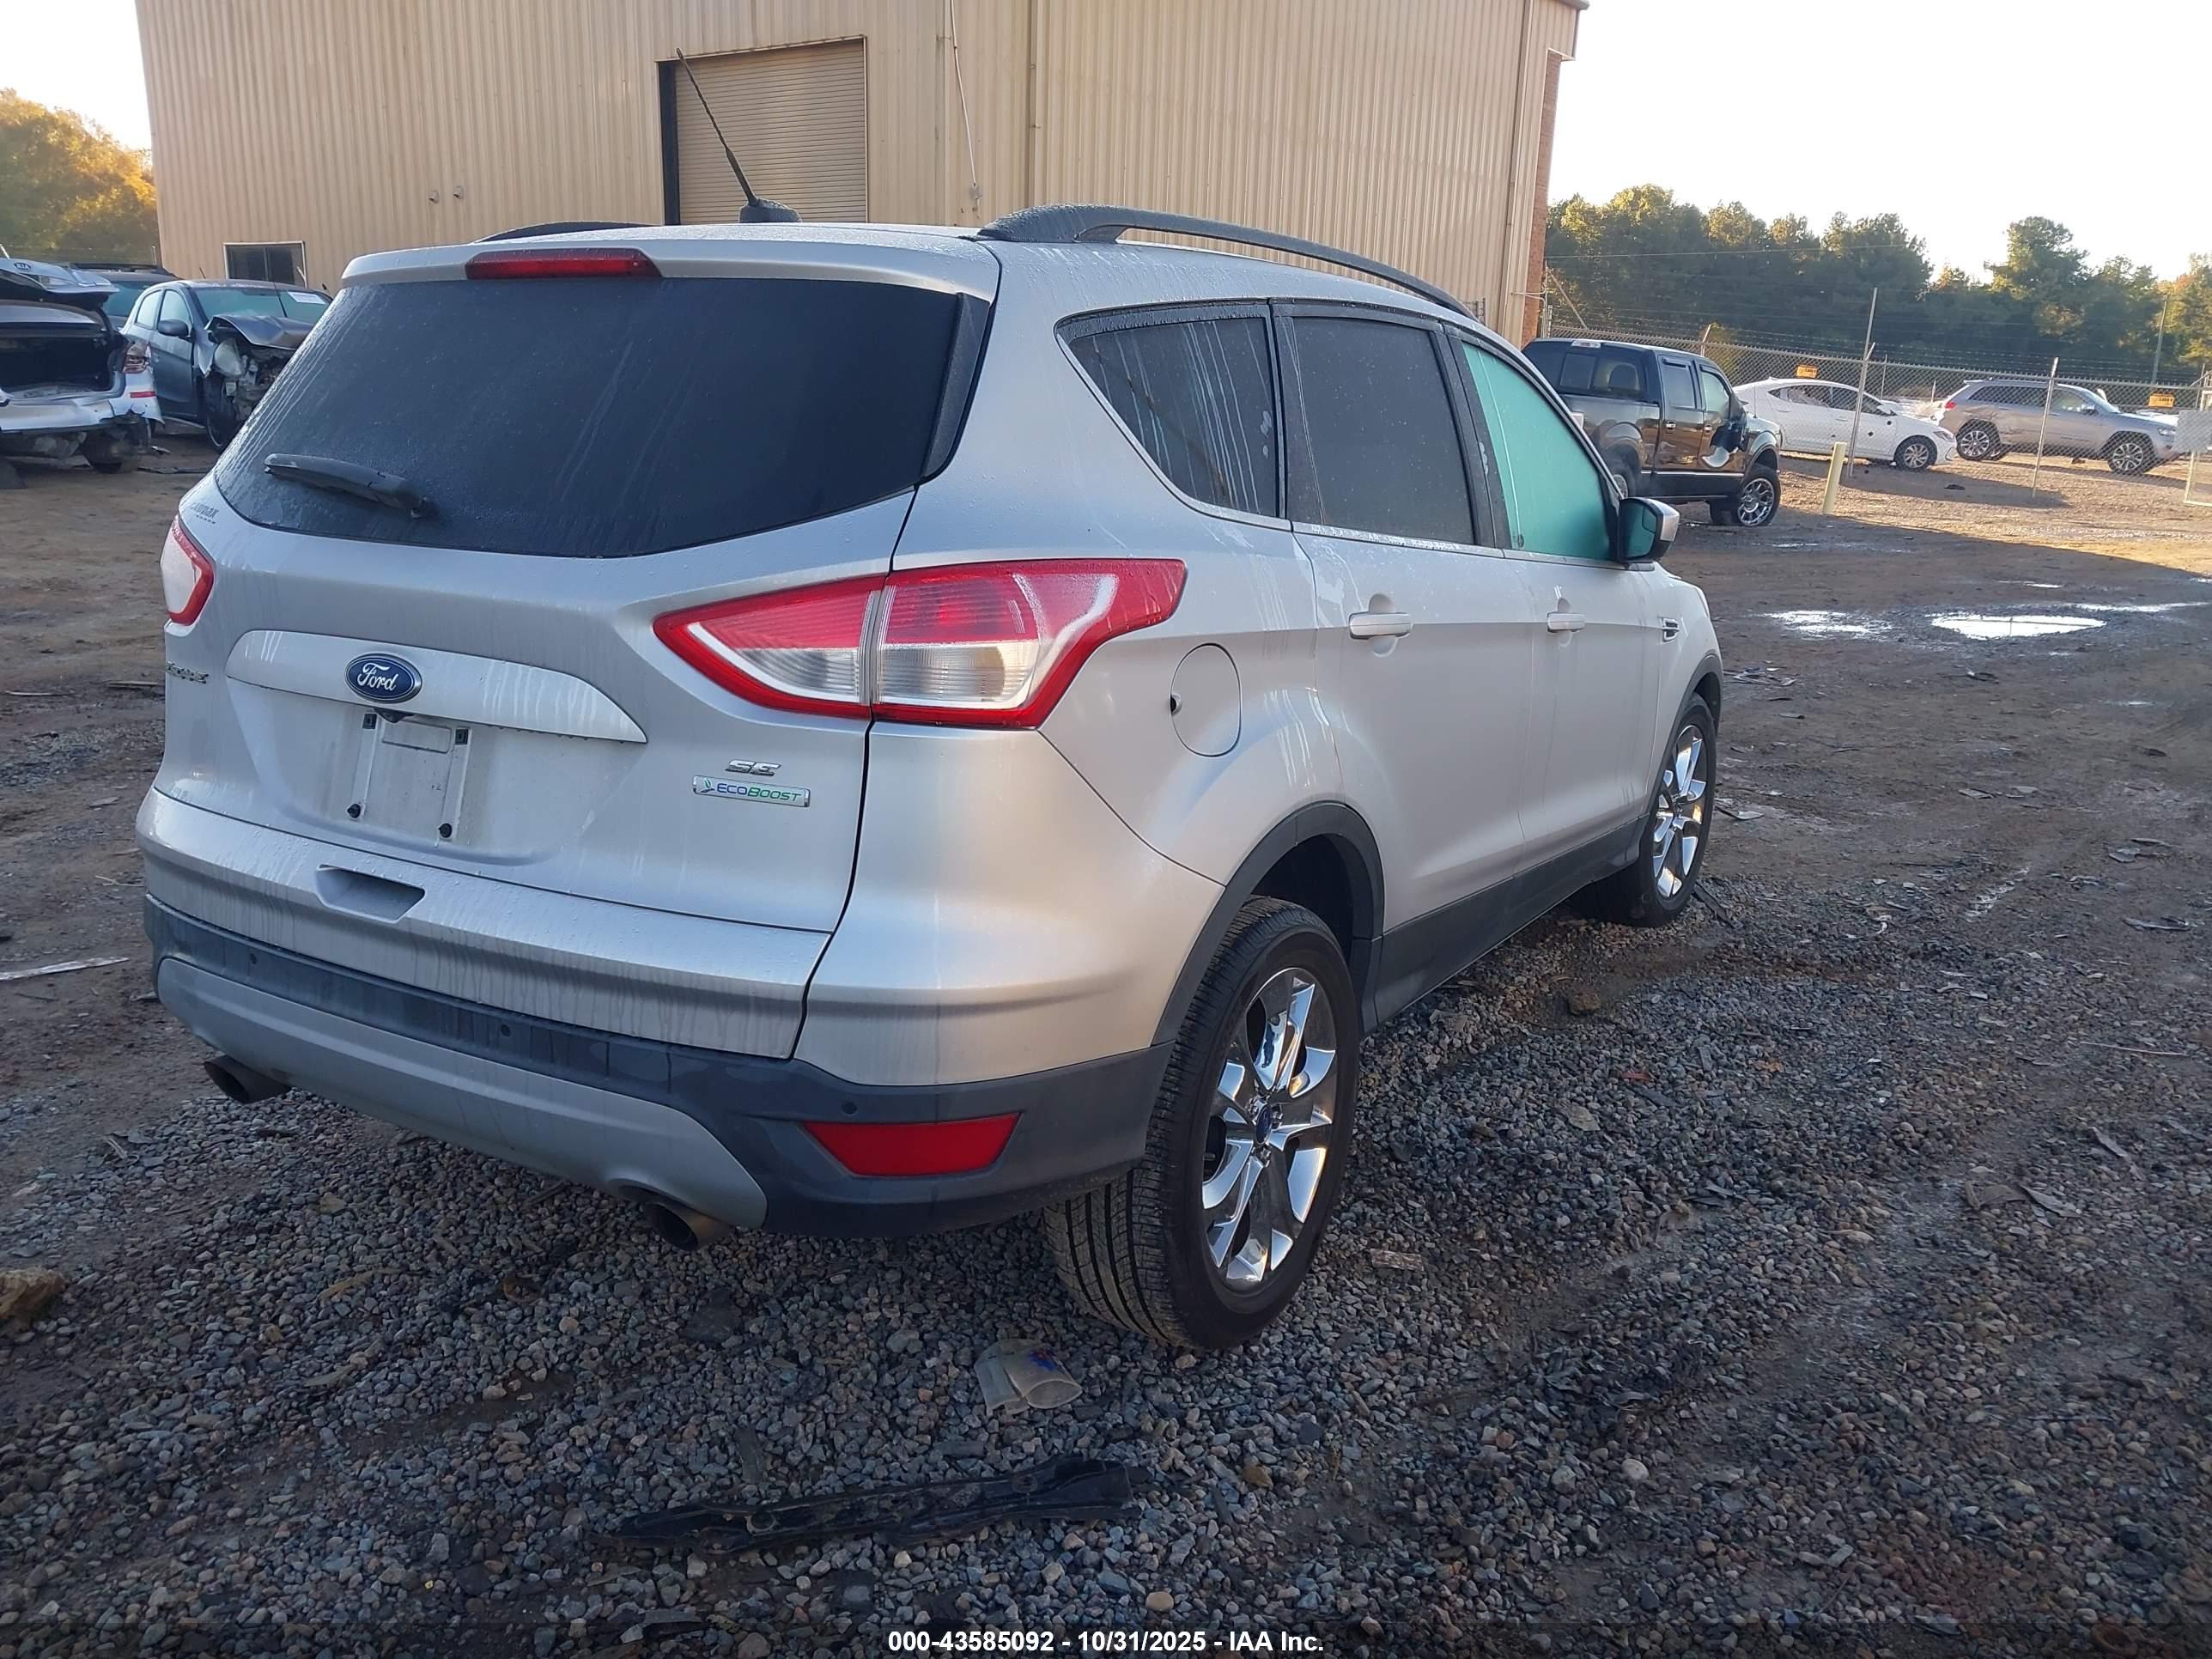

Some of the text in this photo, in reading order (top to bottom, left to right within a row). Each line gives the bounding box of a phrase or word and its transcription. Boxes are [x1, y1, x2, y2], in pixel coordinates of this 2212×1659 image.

[356, 662, 399, 691] Ford
[725, 759, 781, 777] SE
[716, 782, 802, 802] ECOBOOST
